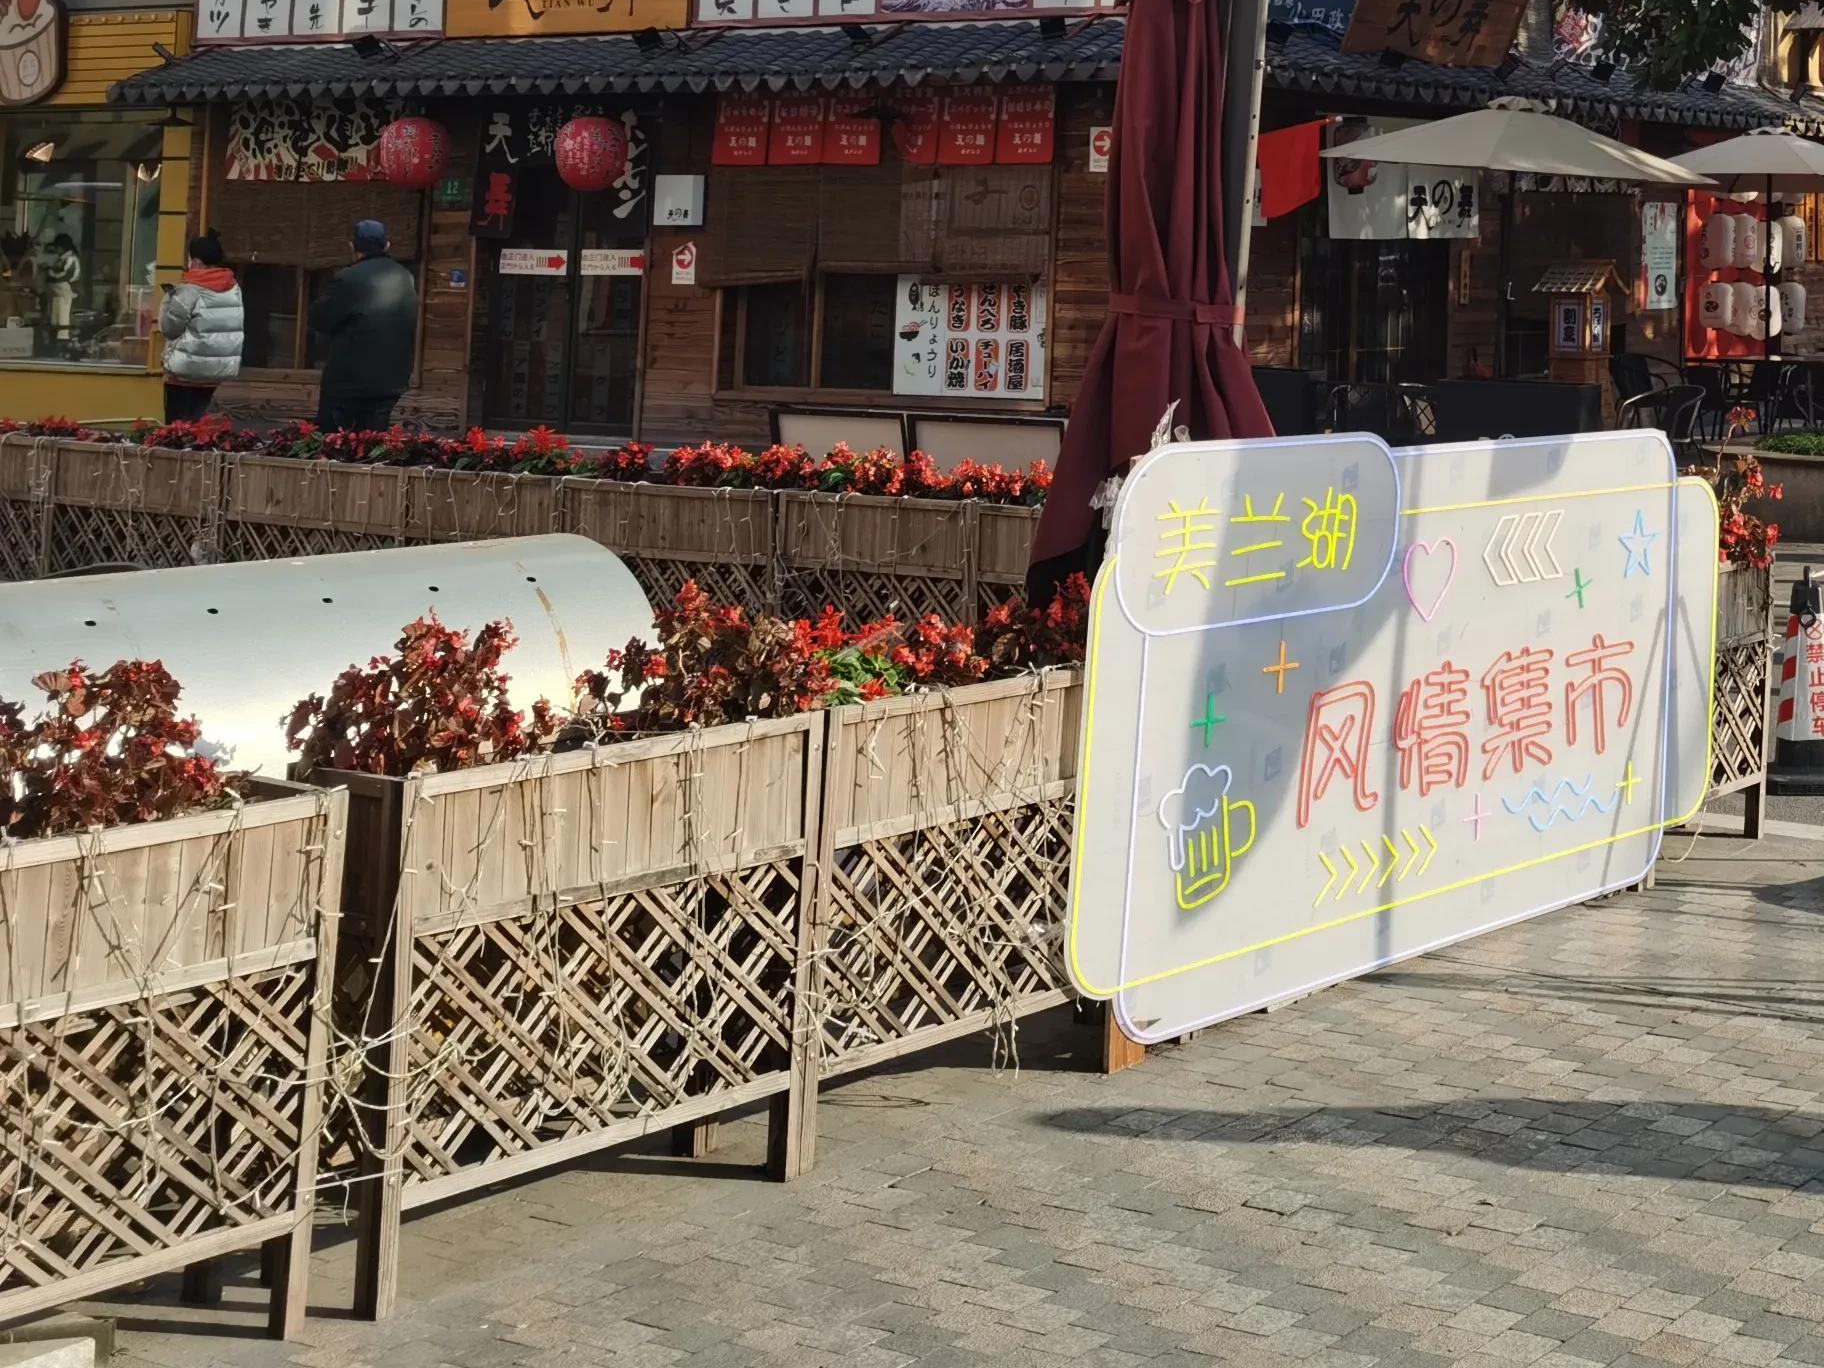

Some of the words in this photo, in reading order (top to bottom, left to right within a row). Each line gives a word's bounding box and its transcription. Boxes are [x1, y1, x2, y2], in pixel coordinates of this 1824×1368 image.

[1408, 179, 1474, 230] 天の舞
[1006, 342, 1025, 390] 居酒屋
[1155, 486, 1358, 596] 美兰湖
[1296, 632, 1635, 830] 风情集市
